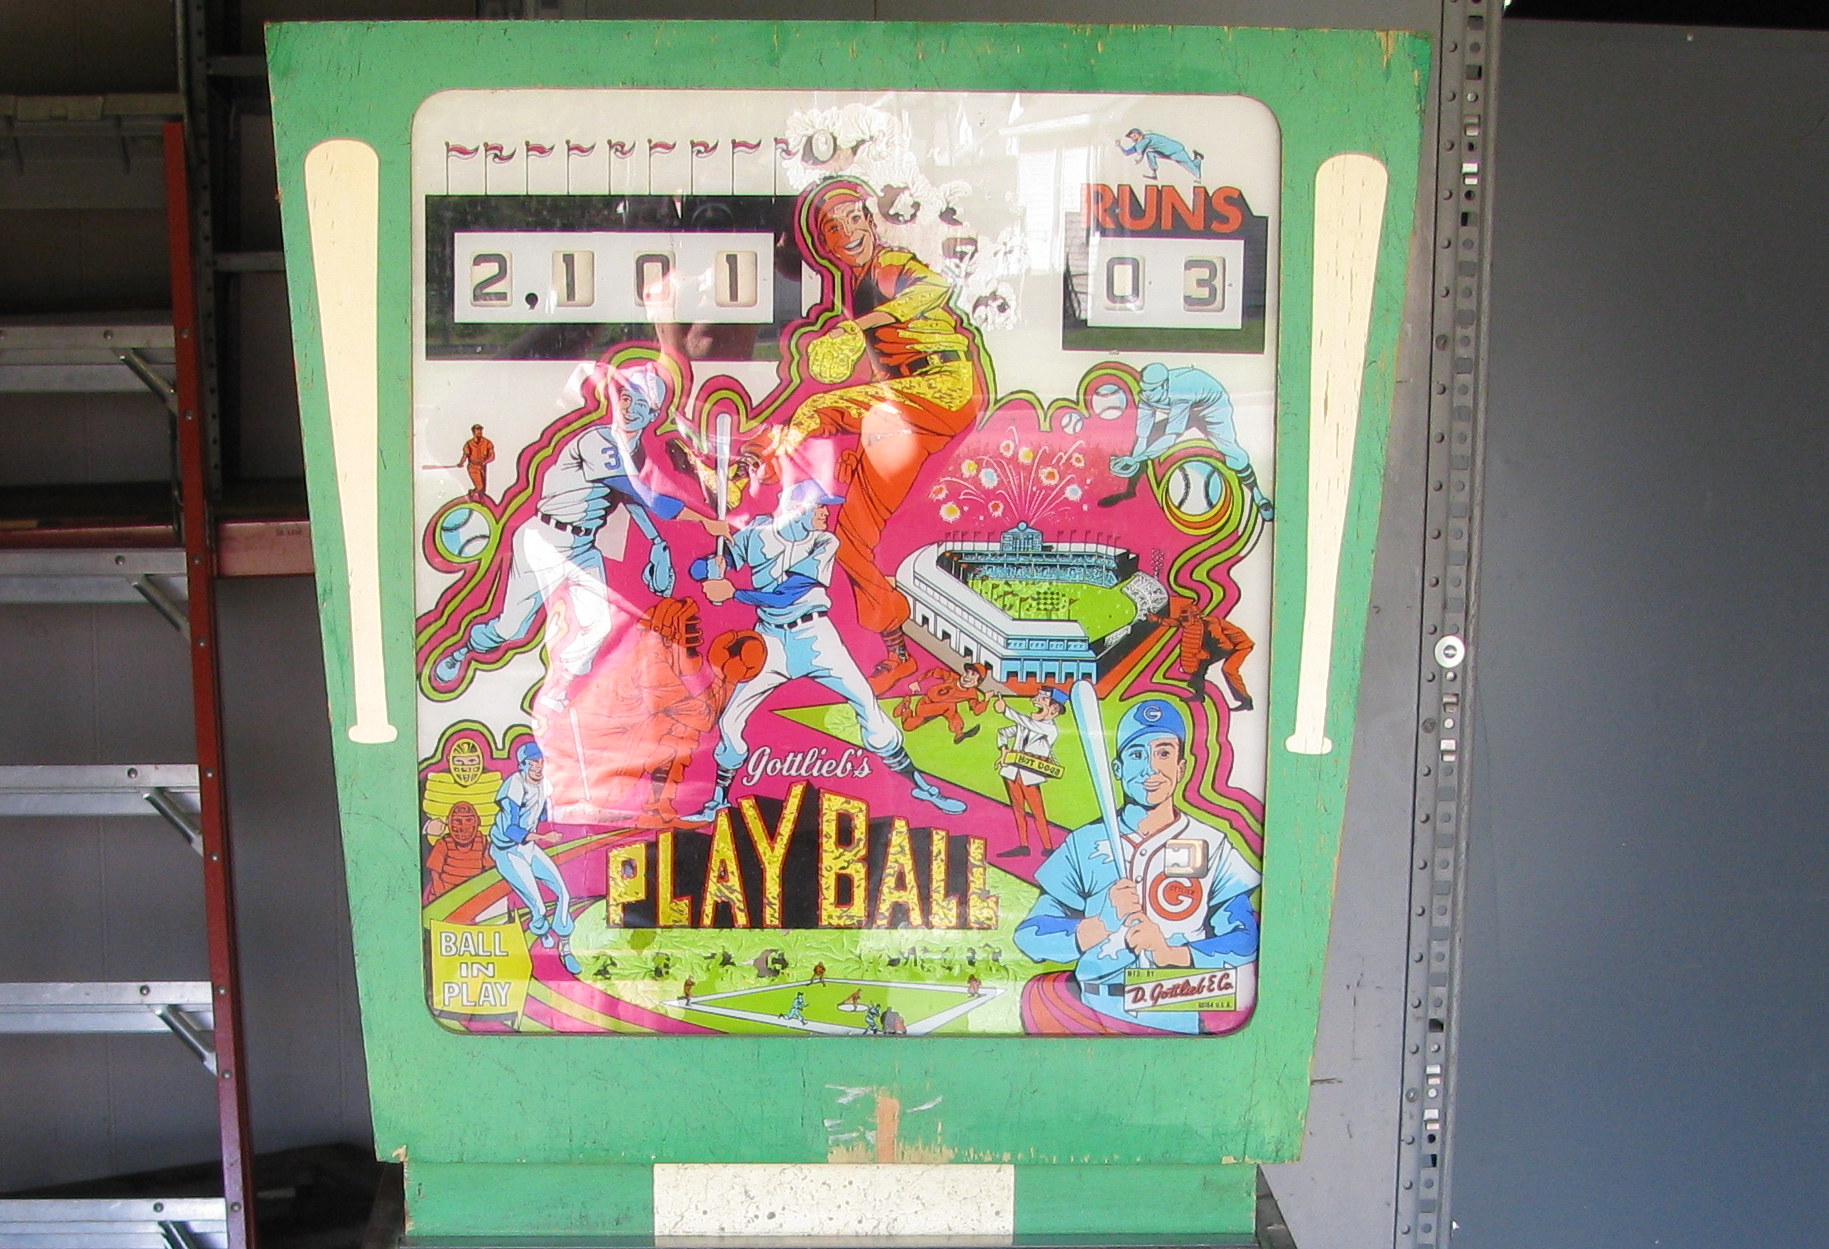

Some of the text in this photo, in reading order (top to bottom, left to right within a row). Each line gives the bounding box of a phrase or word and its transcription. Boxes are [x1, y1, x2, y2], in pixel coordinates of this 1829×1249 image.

[1080, 183, 1245, 234] RUNS
[742, 745, 872, 786] Gottlieb's
[606, 781, 1000, 929] PLAY BALL
[440, 930, 508, 957] BALL
[459, 962, 495, 978] IN
[442, 983, 512, 1007] PLAY
[1150, 976, 1205, 1006] Gottlieb
